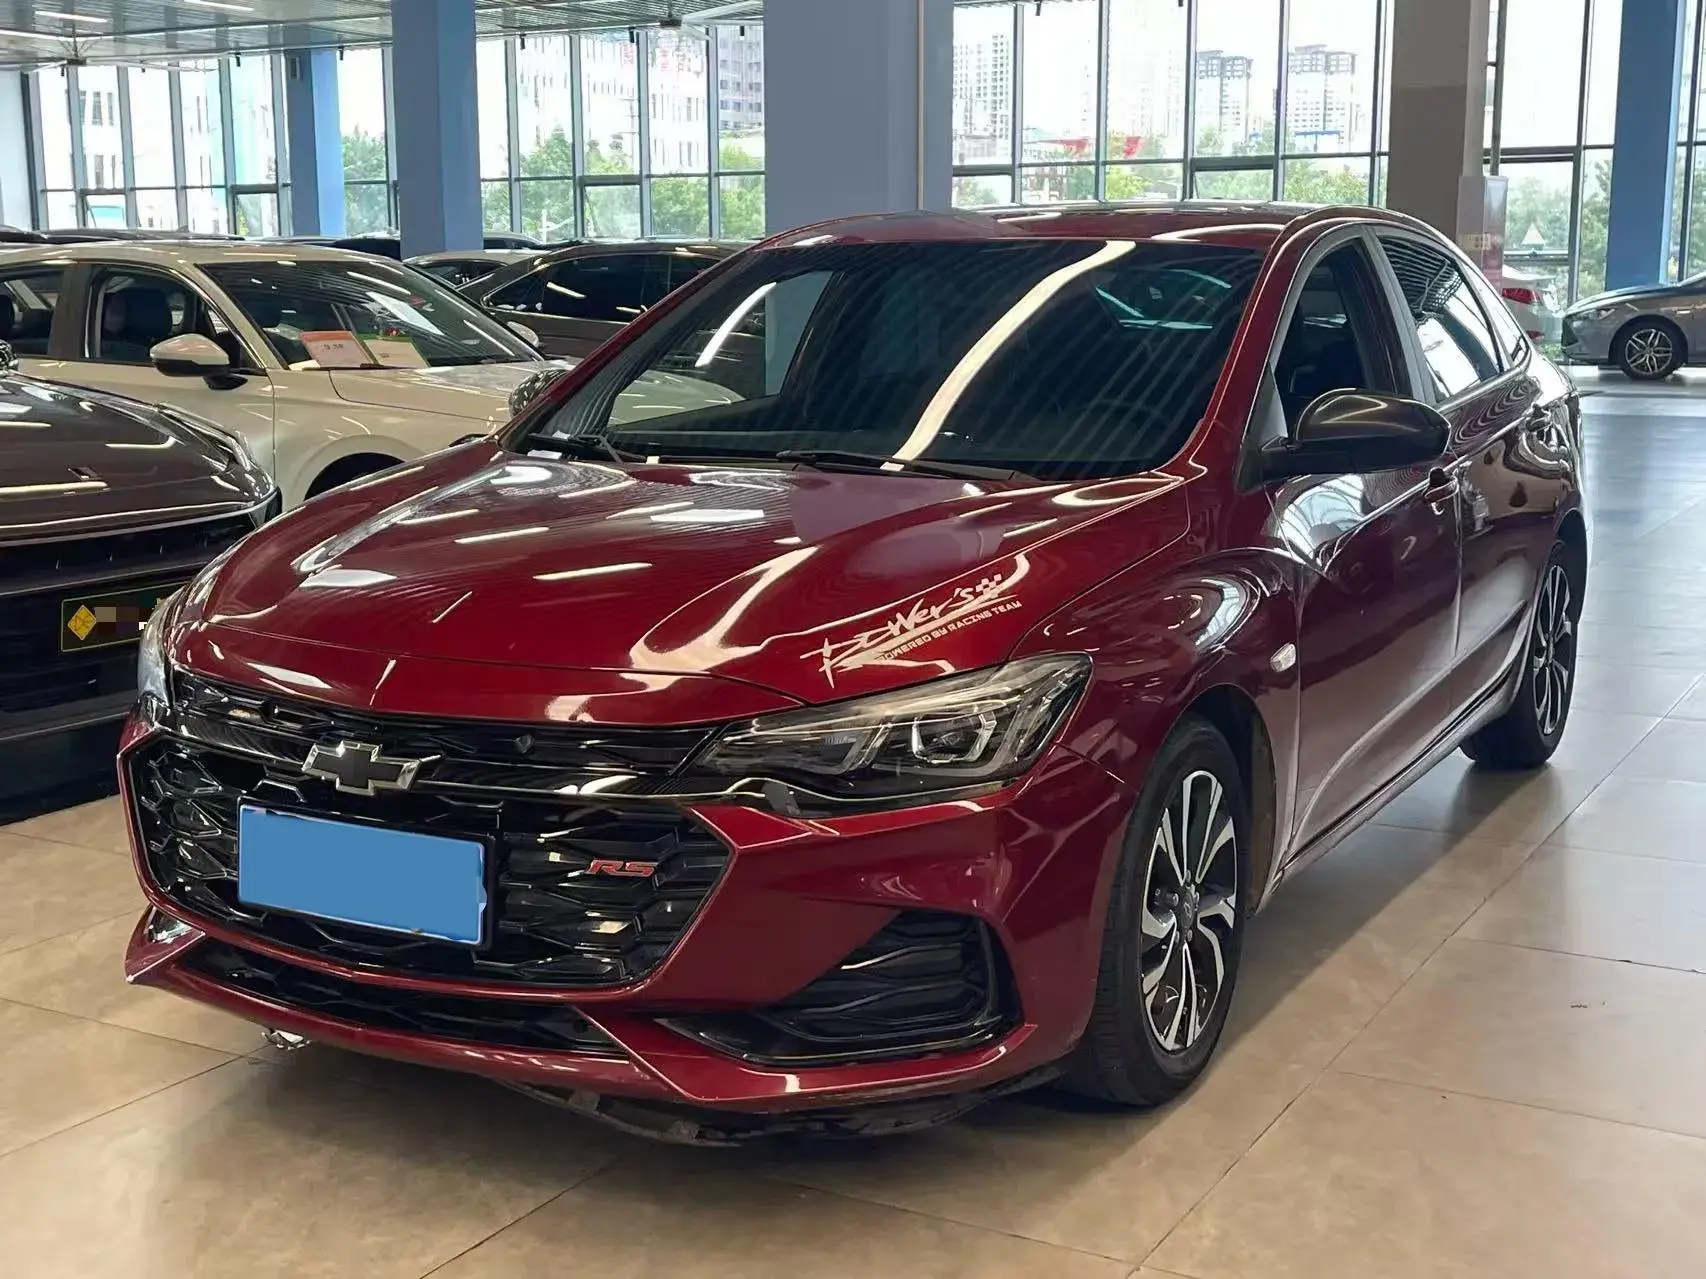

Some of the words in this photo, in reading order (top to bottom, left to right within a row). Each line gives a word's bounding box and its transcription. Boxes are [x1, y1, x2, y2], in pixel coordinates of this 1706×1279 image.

[933, 627, 949, 639] BY
[948, 611, 993, 632] RACING
[991, 600, 1023, 615] TEAM
[585, 859, 659, 878] RS
